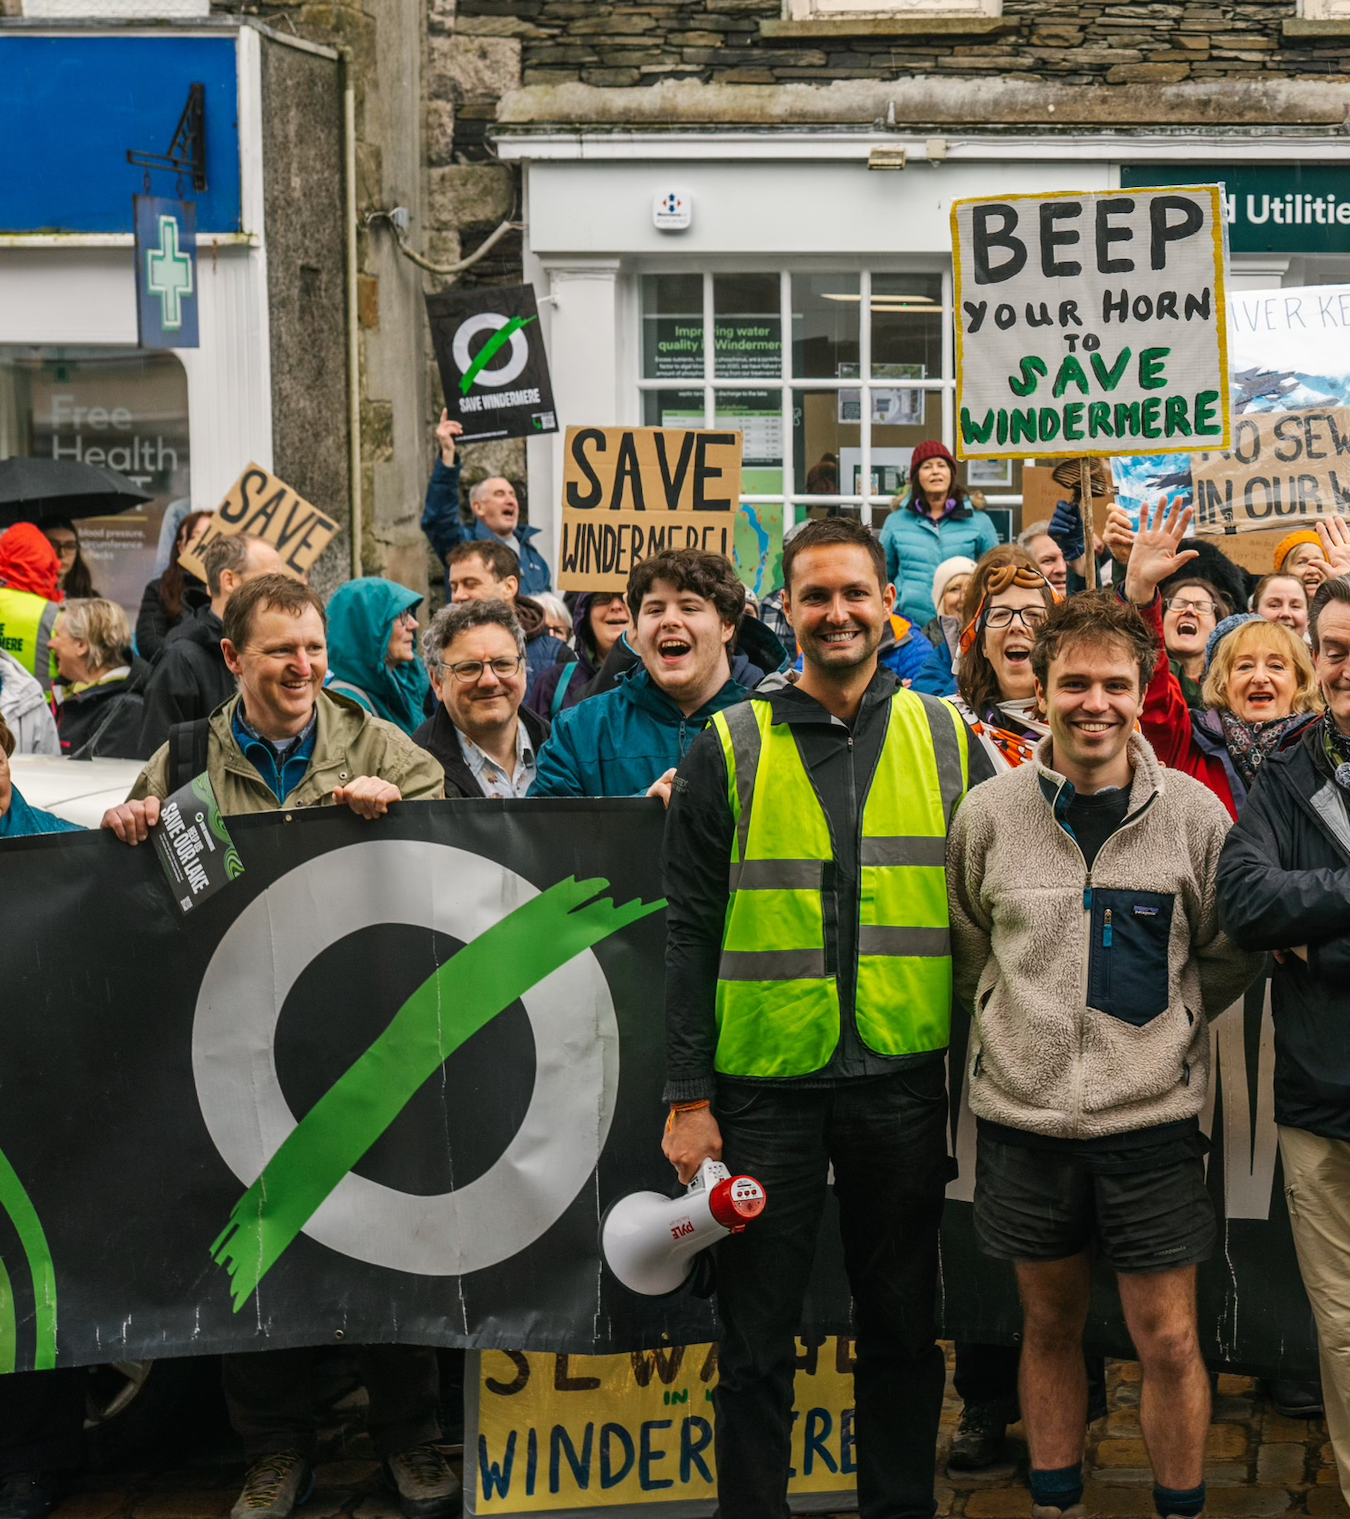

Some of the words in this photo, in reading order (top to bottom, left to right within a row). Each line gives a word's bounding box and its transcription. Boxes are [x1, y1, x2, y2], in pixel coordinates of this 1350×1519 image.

[973, 196, 1203, 285] BEEP
[963, 300, 1083, 333] YOUR
[1103, 287, 1210, 323] HORN
[1231, 298, 1306, 332] IVER
[658, 340, 698, 352] quality
[675, 326, 734, 338] Impring
[736, 327, 770, 336] water
[1064, 333, 1100, 352] TO
[1008, 346, 1171, 398] SAVE
[51, 393, 132, 430] Free
[459, 395, 482, 413] SAVE
[482, 388, 541, 409] WINDERMERE
[960, 390, 1221, 445] WINDERMERE
[53, 435, 178, 471] Health
[567, 428, 735, 511] SAVE
[1197, 479, 1233, 524] IN
[1244, 474, 1323, 518] OUR
[220, 469, 334, 574] SAVE
[161, 802, 186, 839] SAVE
[173, 832, 196, 866] OUR
[184, 857, 210, 895] LAKE
[664, 1388, 689, 1406] IN
[478, 1407, 858, 1501] WINDERRE
